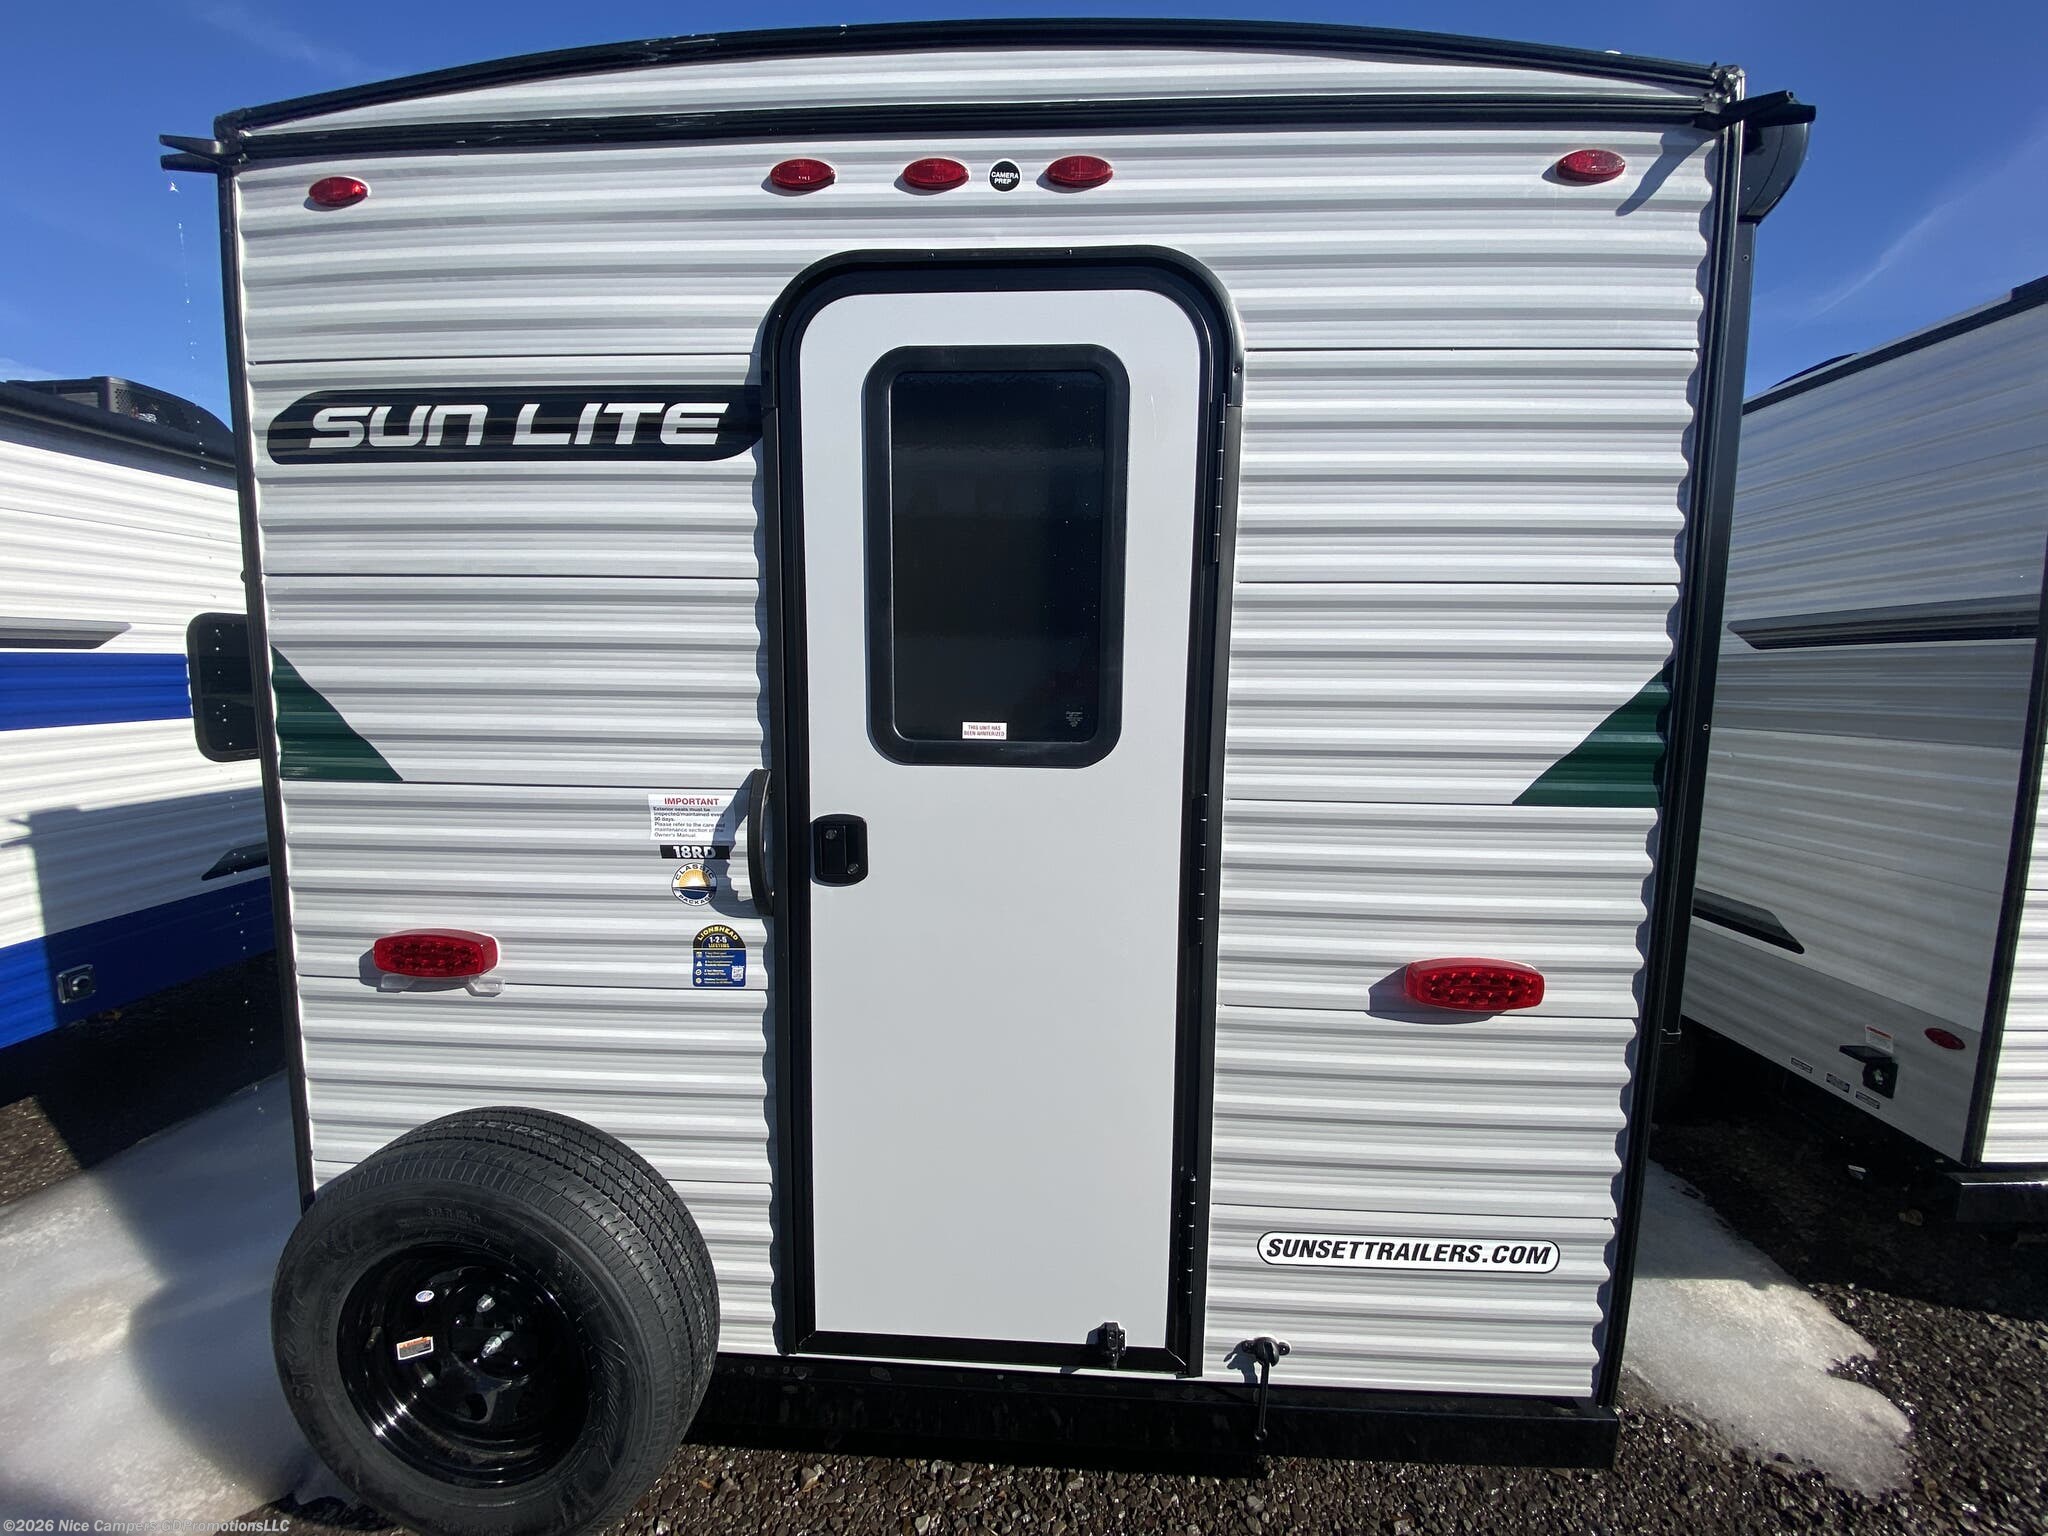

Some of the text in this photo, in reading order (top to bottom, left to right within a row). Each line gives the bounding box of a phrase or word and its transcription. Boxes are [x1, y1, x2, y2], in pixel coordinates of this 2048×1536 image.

[991, 171, 1019, 179] CAMERA
[309, 403, 729, 448] SUN LITE
[664, 797, 719, 805] IMPORTANT
[673, 845, 716, 859] 18RD
[675, 864, 714, 880] CLASSIC
[678, 893, 714, 904] PACKAGE
[697, 926, 739, 941] LIONSHEAD
[1266, 1238, 1551, 1265] SUNSETTRAILERS.COM
